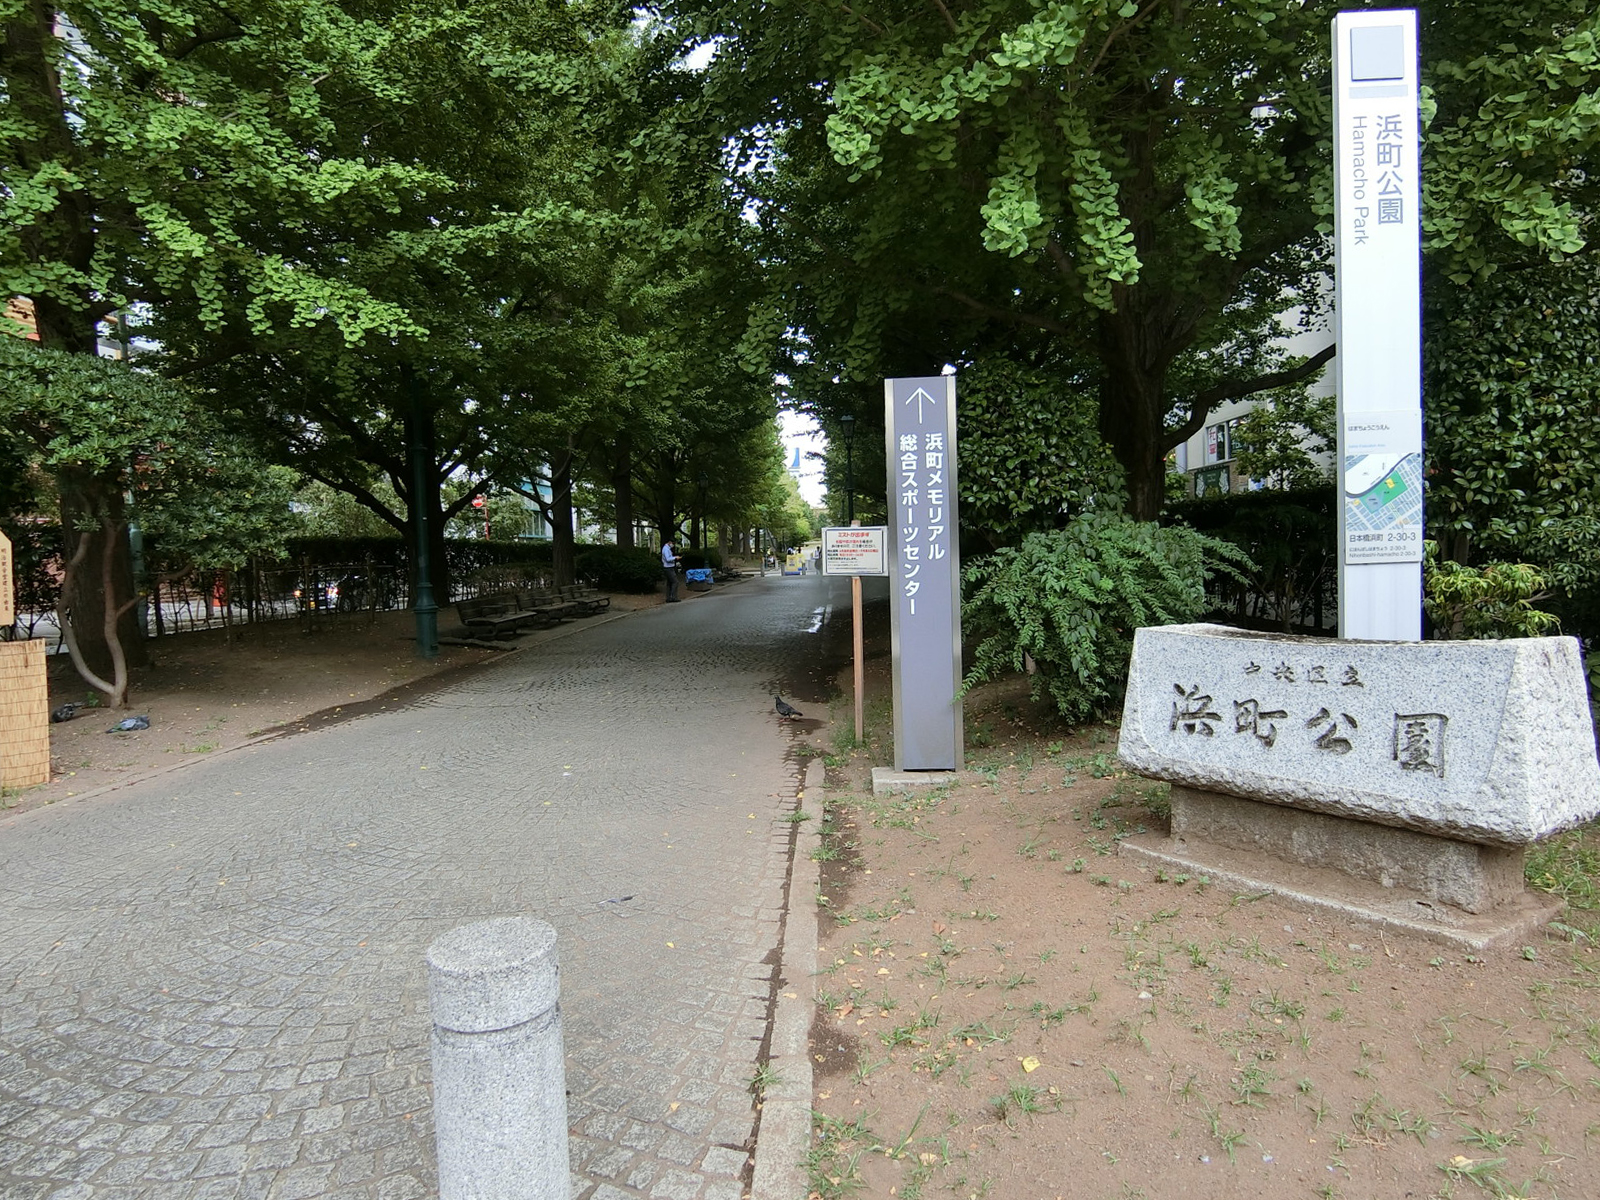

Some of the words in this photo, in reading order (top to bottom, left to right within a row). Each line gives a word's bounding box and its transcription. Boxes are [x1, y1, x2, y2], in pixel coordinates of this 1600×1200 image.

[1353, 116, 1368, 200] Hamacho
[1376, 114, 1403, 225] 浜町公園
[1354, 207, 1369, 245] Park
[900, 434, 920, 615] 総合スポーツセンター
[925, 433, 945, 560] 浜町メモリアル
[1349, 533, 1383, 543] 日本橋浜町
[1387, 531, 1416, 542] 2-30-3
[1244, 661, 1364, 688] 中央区立
[1169, 683, 1449, 778] 浜町公園
